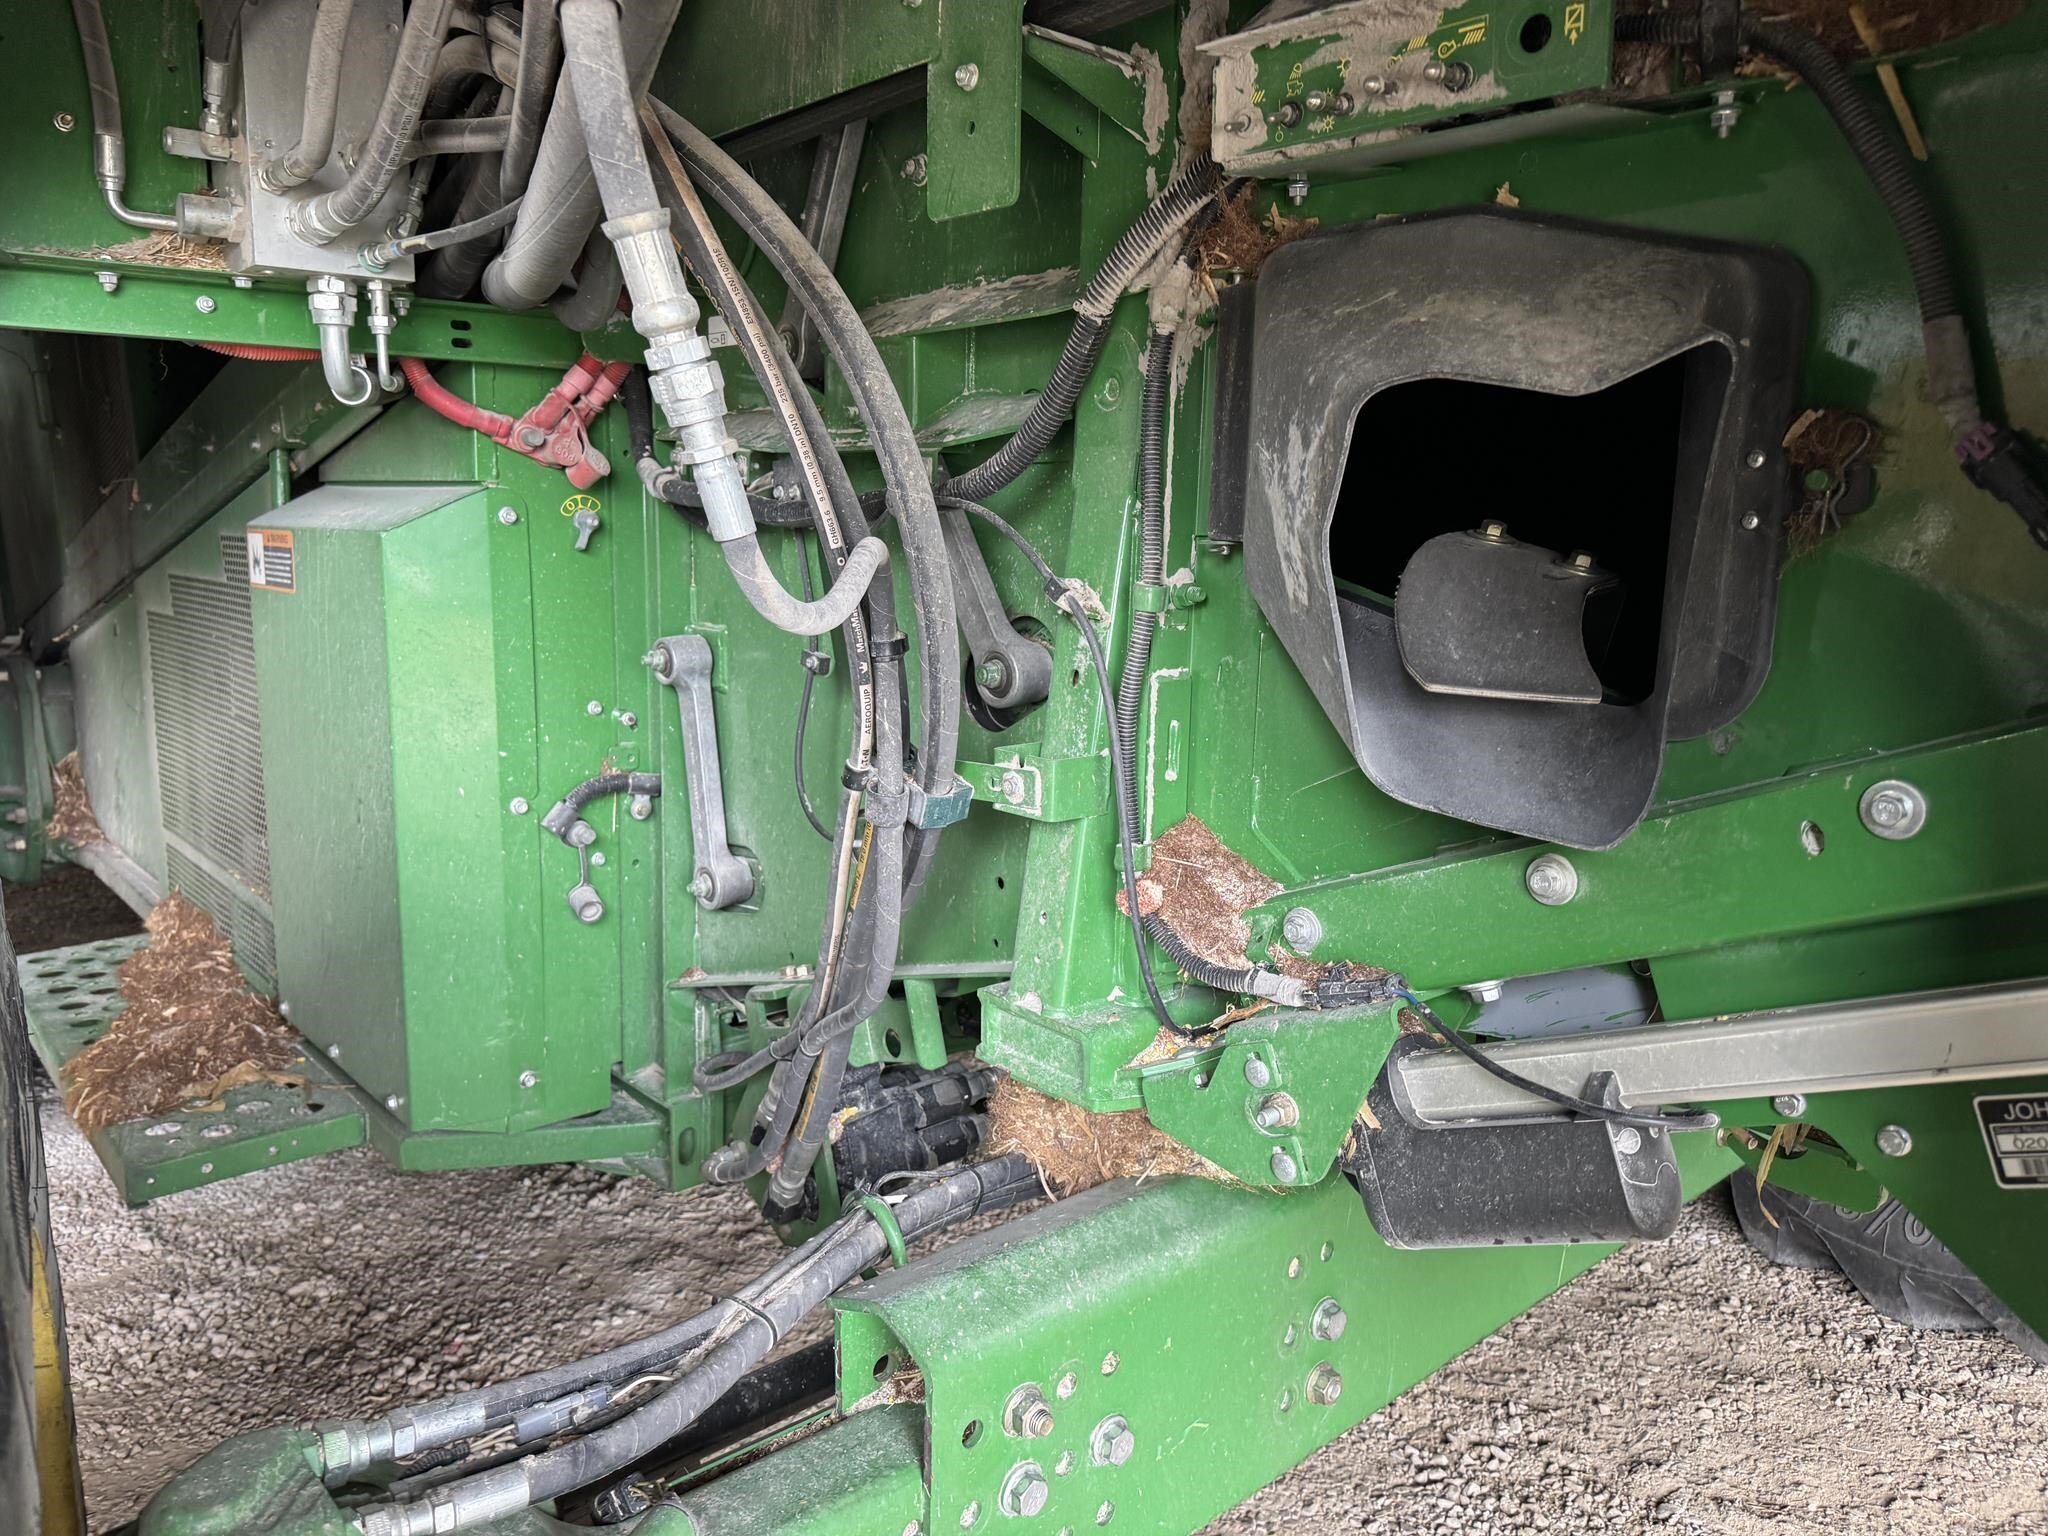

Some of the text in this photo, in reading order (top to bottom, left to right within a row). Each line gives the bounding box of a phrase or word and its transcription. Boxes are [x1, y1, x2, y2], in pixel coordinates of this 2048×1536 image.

[753, 332, 768, 349] psi)
[761, 346, 777, 371] (3400
[773, 371, 783, 388] bar
[778, 388, 788, 404] 235
[788, 413, 803, 437] DN10
[811, 471, 821, 488] mm
[817, 489, 826, 502] 9.5
[863, 688, 872, 735] AEROQUIP
